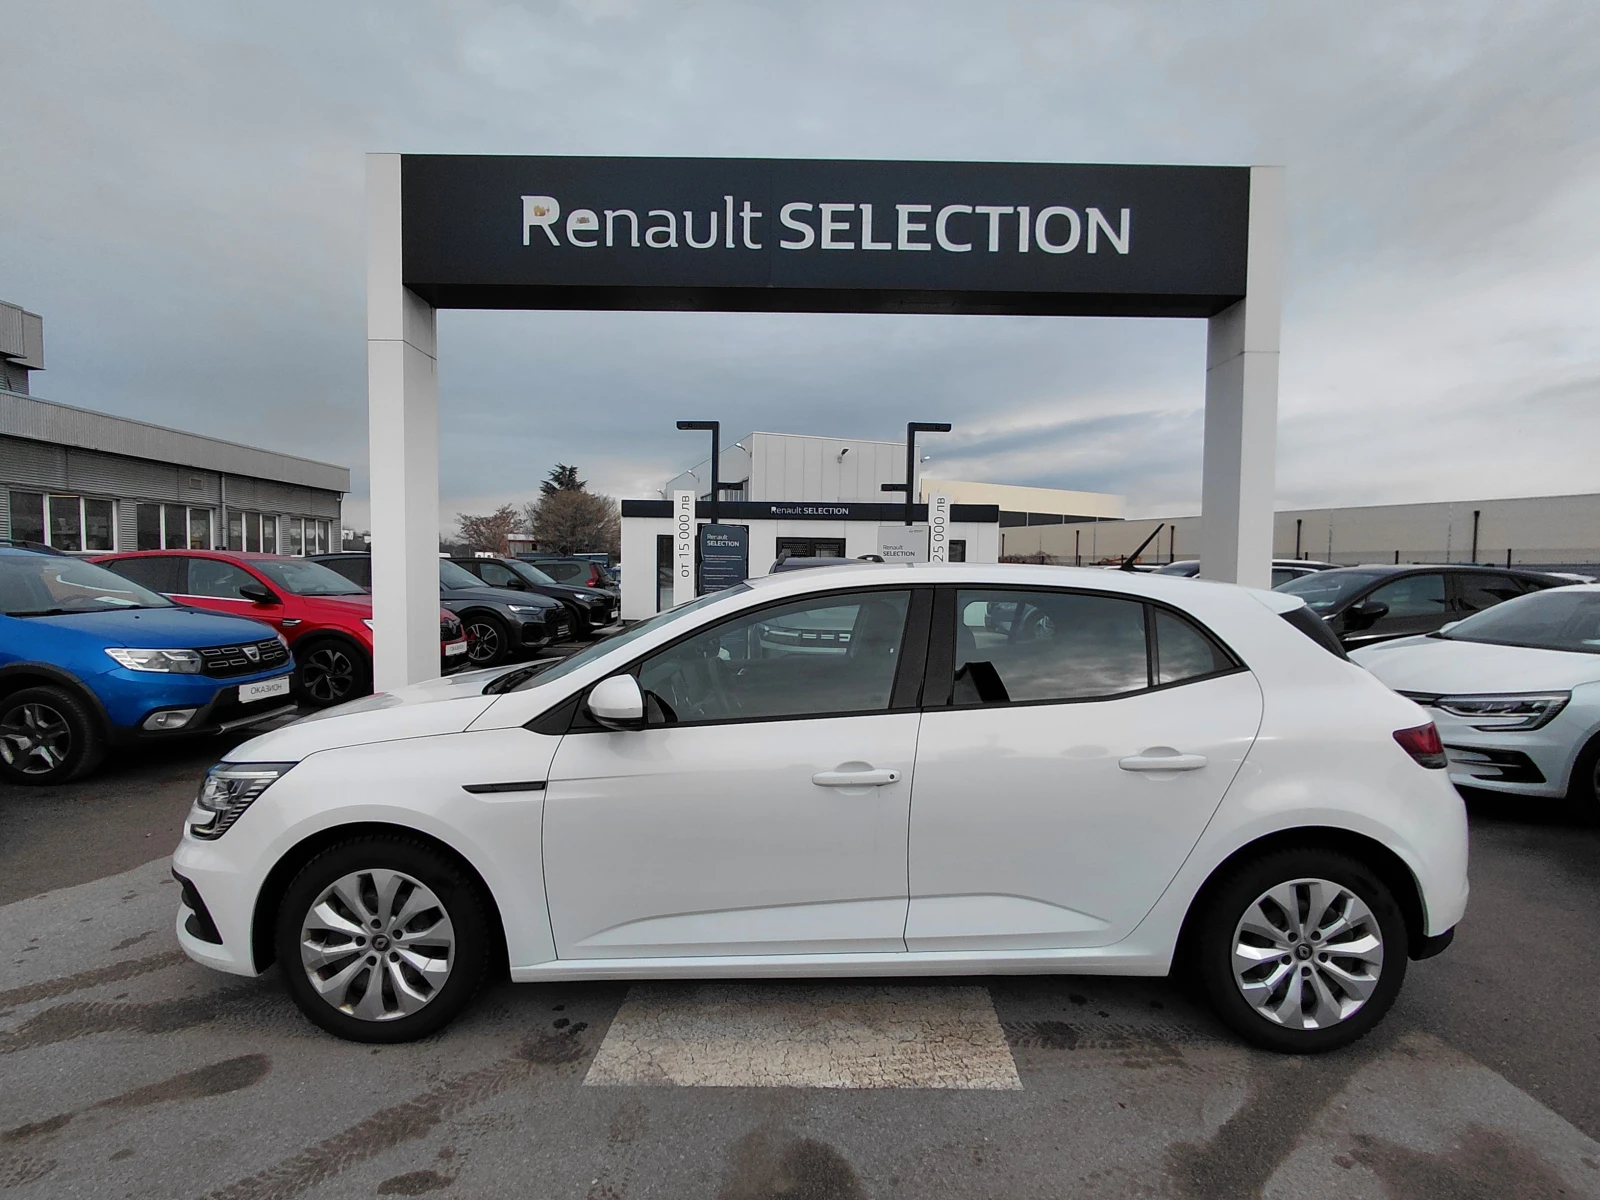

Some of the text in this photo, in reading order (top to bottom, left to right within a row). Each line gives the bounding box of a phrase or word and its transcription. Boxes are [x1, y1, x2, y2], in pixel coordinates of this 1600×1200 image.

[520, 194, 1131, 255] Renault SELECTION
[770, 506, 849, 515] Renault SELECTION
[679, 514, 690, 540] 000
[933, 516, 945, 542] 000
[679, 543, 690, 558] 15
[932, 545, 944, 563] 25
[250, 683, 282, 695] ОКАЗИОН
